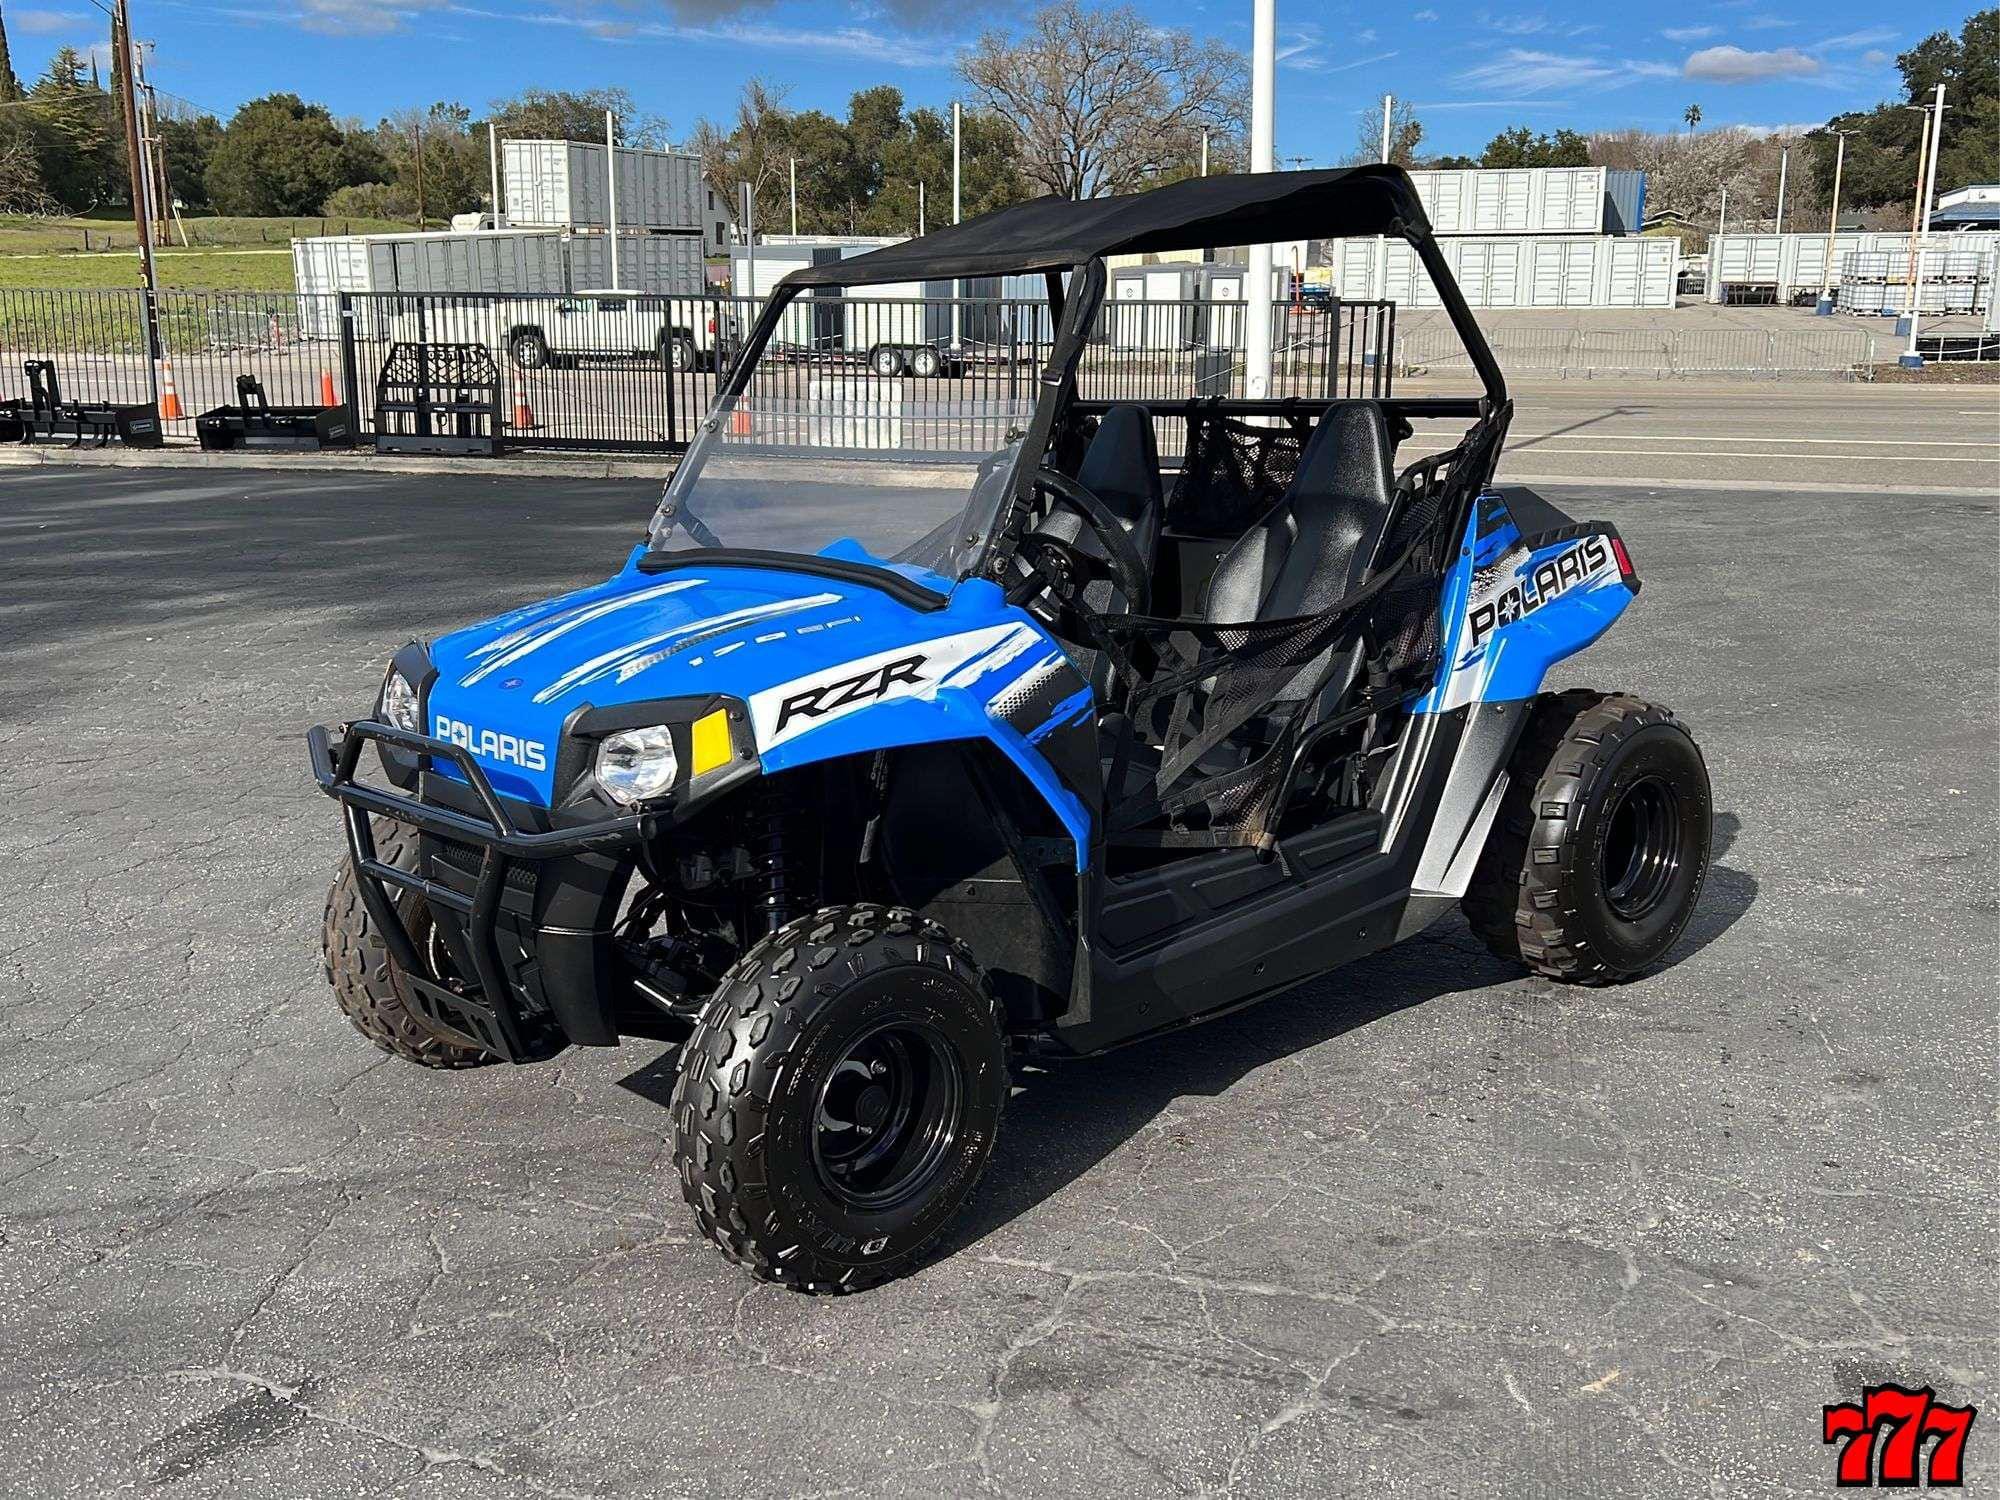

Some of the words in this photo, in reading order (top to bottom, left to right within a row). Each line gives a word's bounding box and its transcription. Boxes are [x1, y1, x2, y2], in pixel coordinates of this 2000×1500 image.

[1469, 535, 1607, 648] POLARIS
[774, 655, 929, 735] RZR
[436, 715, 546, 771] POLARIS
